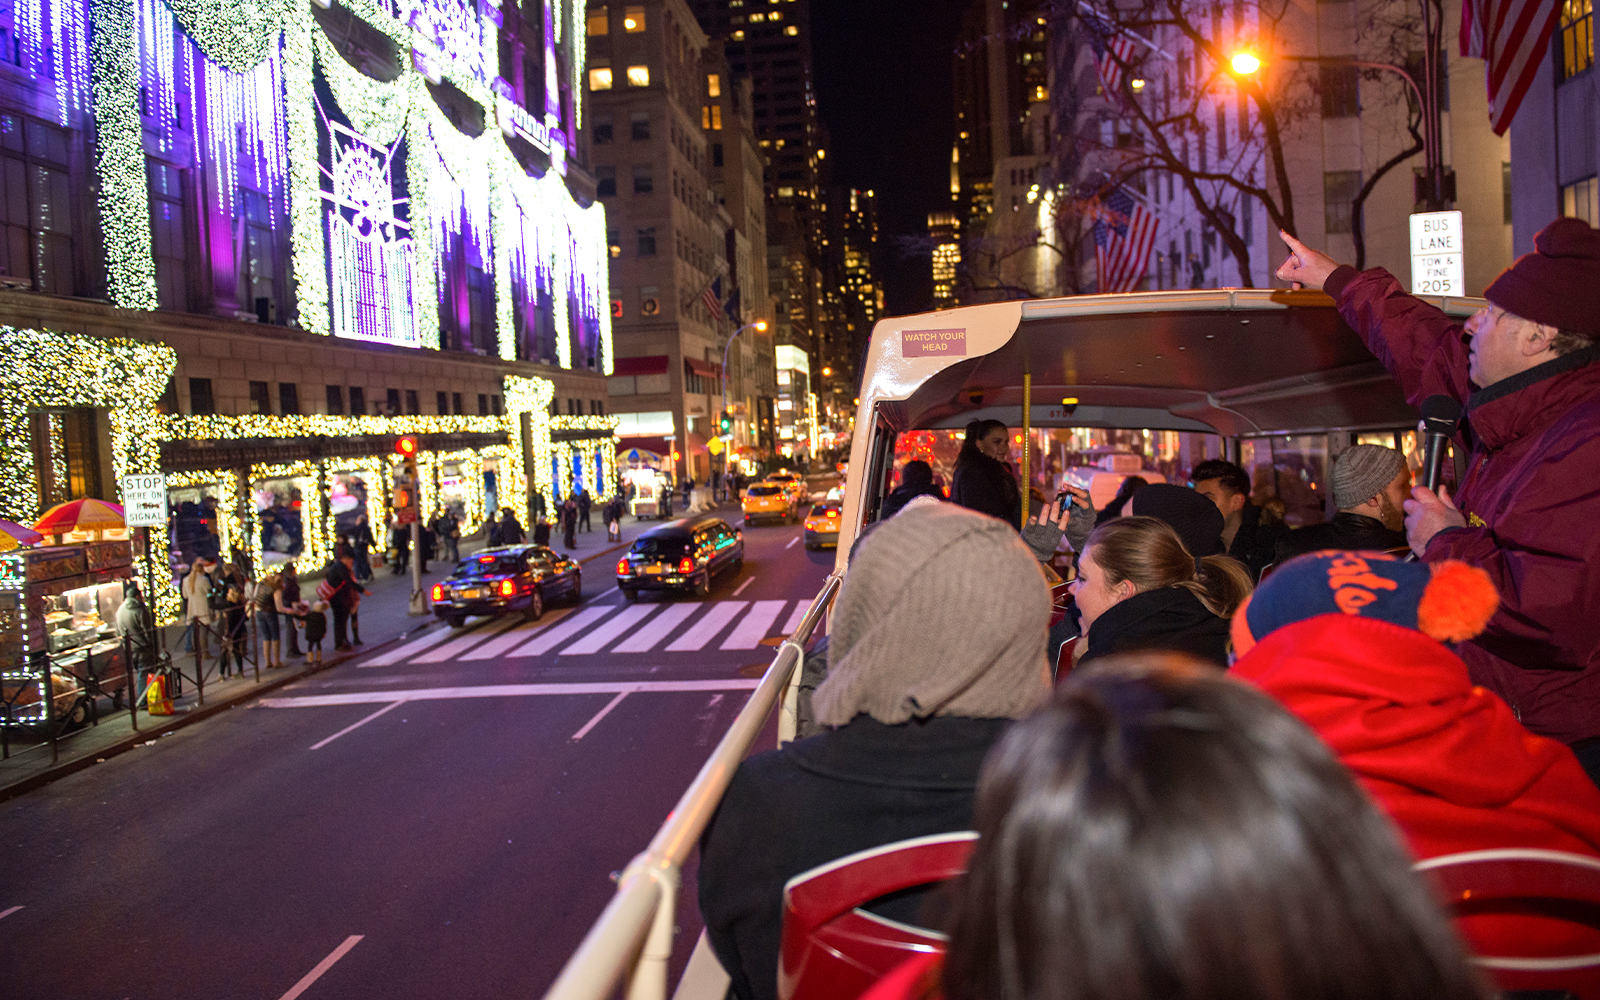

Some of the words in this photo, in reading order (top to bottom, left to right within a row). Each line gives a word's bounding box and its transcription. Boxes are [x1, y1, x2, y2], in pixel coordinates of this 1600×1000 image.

[1423, 218, 1449, 233] BUS
[1420, 235, 1453, 250] LANE
[1421, 257, 1441, 267] TOW
[1446, 256, 1454, 265] &
[1427, 267, 1449, 277] FINE
[904, 333, 937, 342] WATCH
[938, 331, 965, 341] YOUR
[922, 342, 948, 352] HEAD
[126, 477, 161, 490] STOP
[127, 491, 147, 501] HERE
[151, 490, 162, 499] ON
[129, 511, 164, 522] SIGNAL
